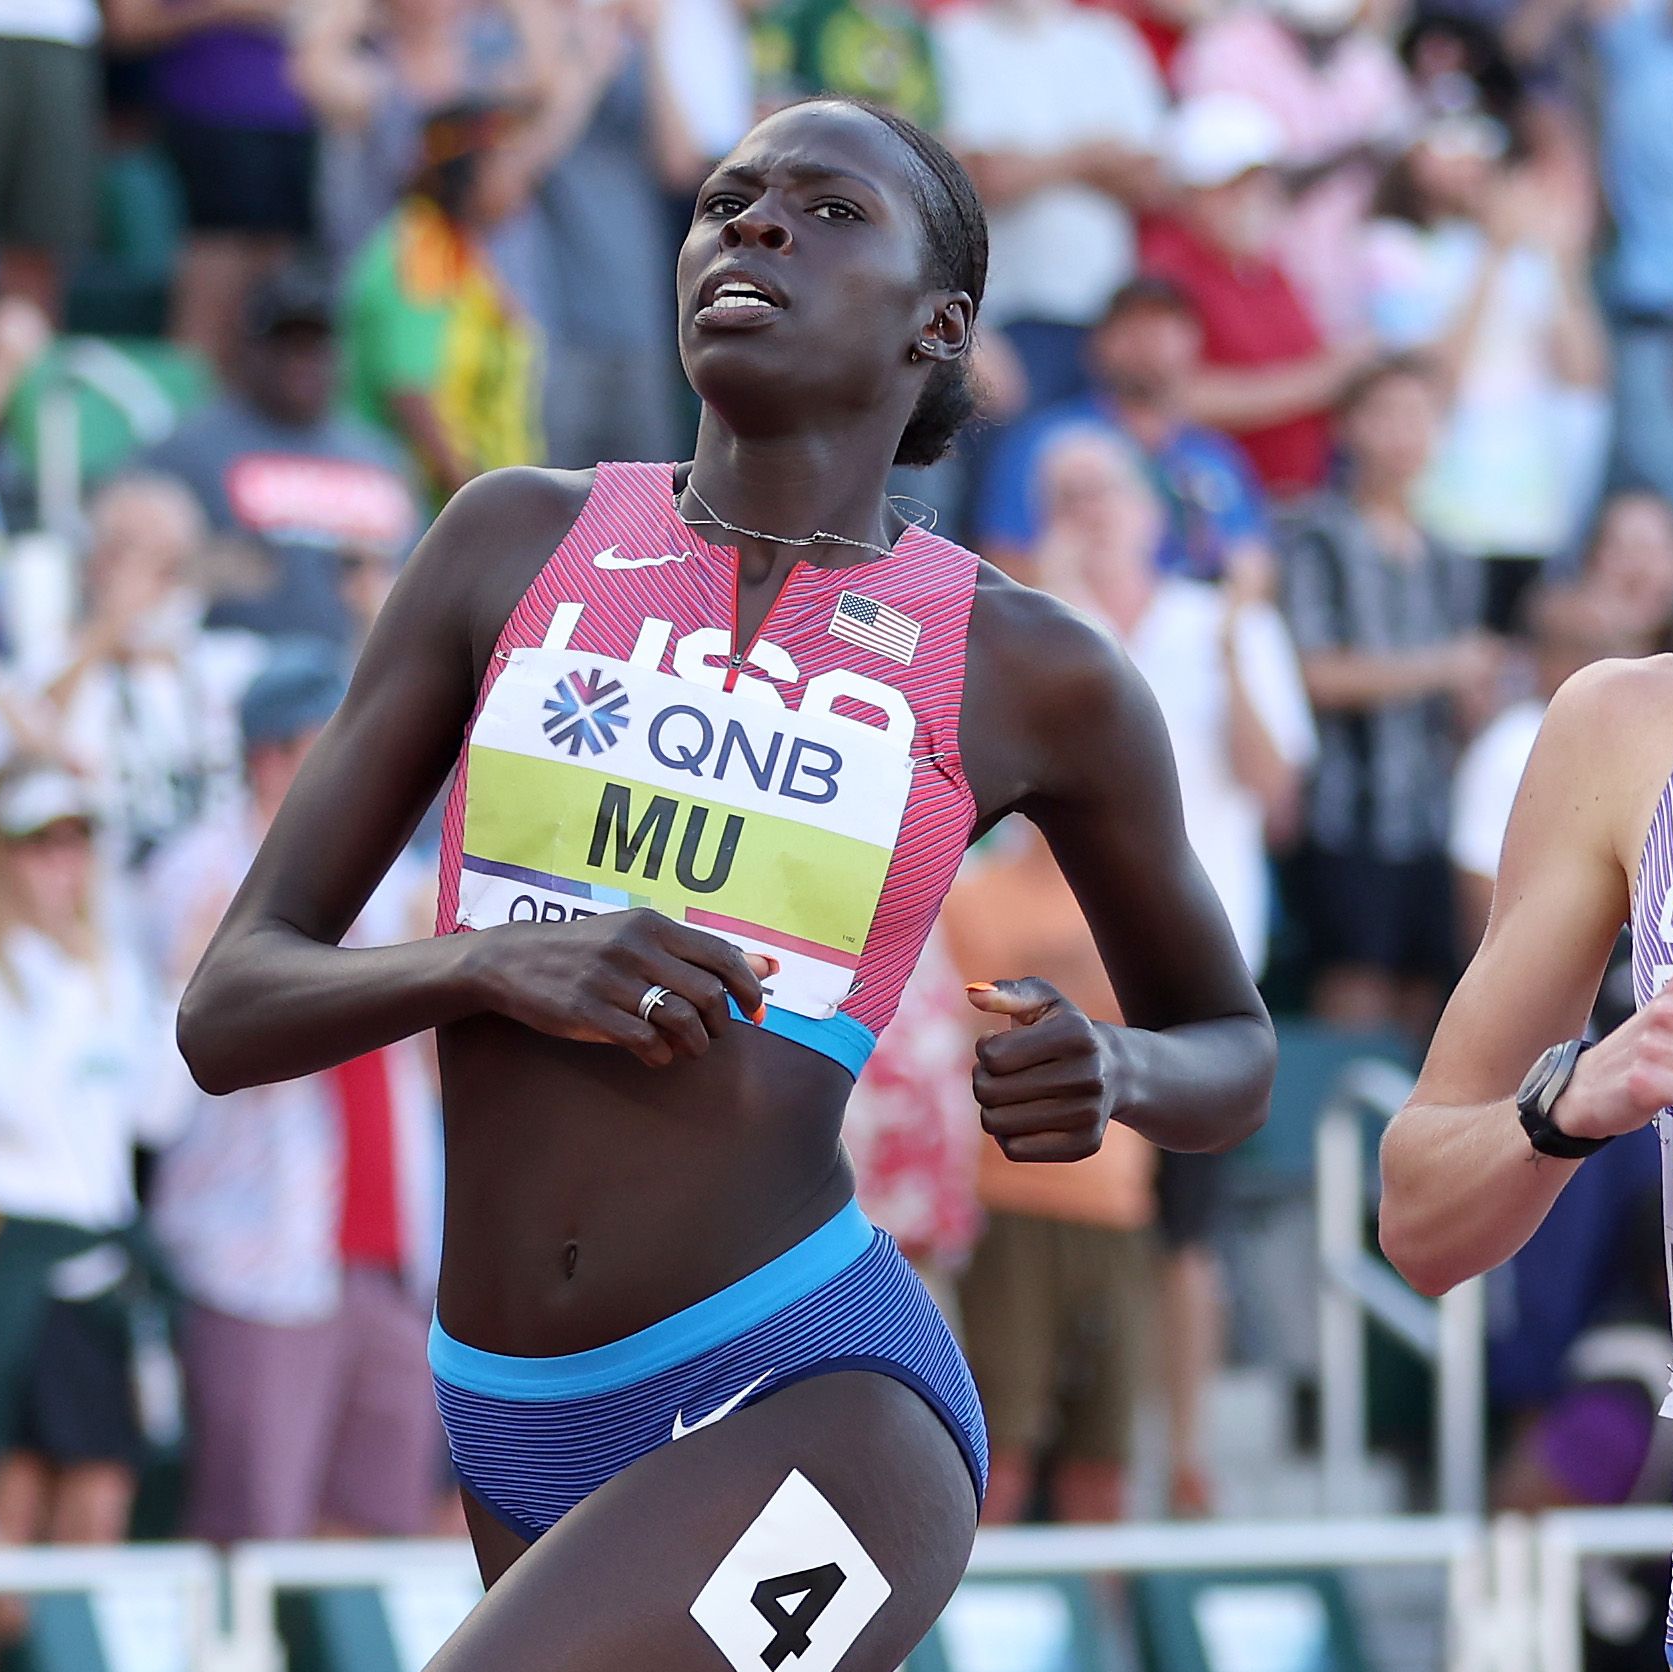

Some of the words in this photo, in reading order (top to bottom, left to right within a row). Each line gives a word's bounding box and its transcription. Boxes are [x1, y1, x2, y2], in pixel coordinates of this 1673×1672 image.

[648, 704, 843, 804] QNB
[587, 782, 745, 893] MU
[750, 1562, 847, 1672] 4
